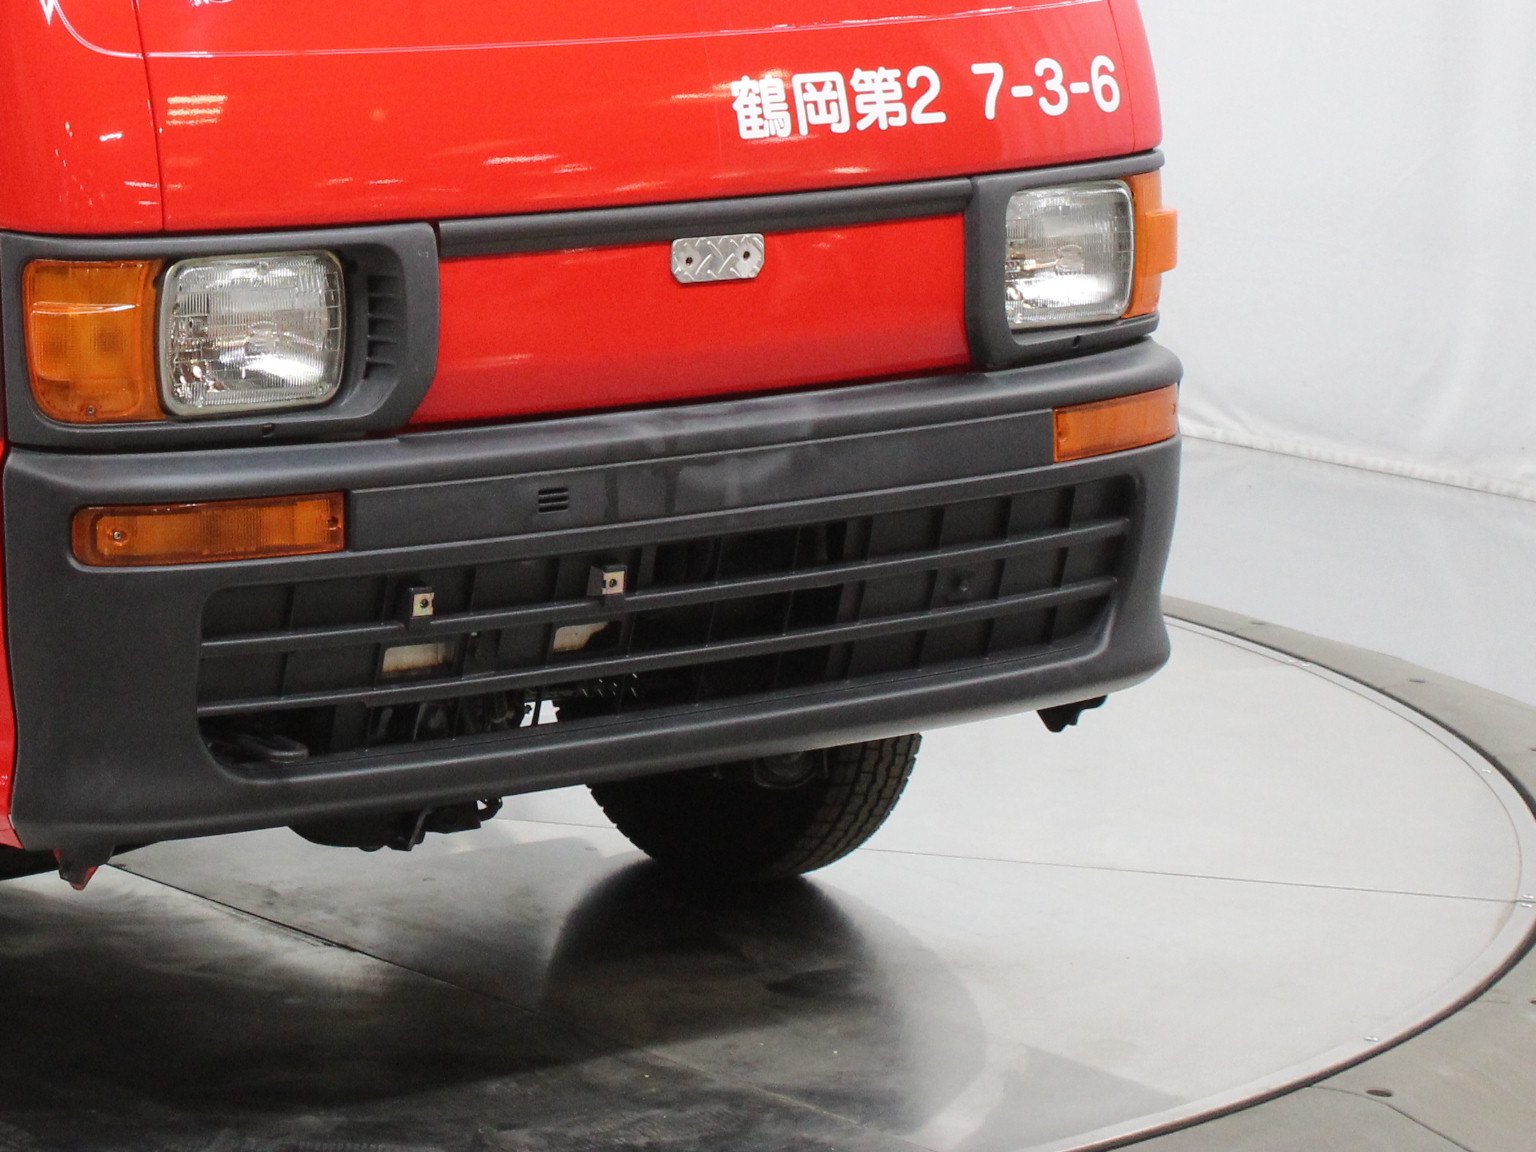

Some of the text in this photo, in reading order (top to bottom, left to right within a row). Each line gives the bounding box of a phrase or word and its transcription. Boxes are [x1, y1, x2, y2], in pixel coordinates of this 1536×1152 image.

[731, 54, 1121, 140] 鶴岡第2 7-3-6
